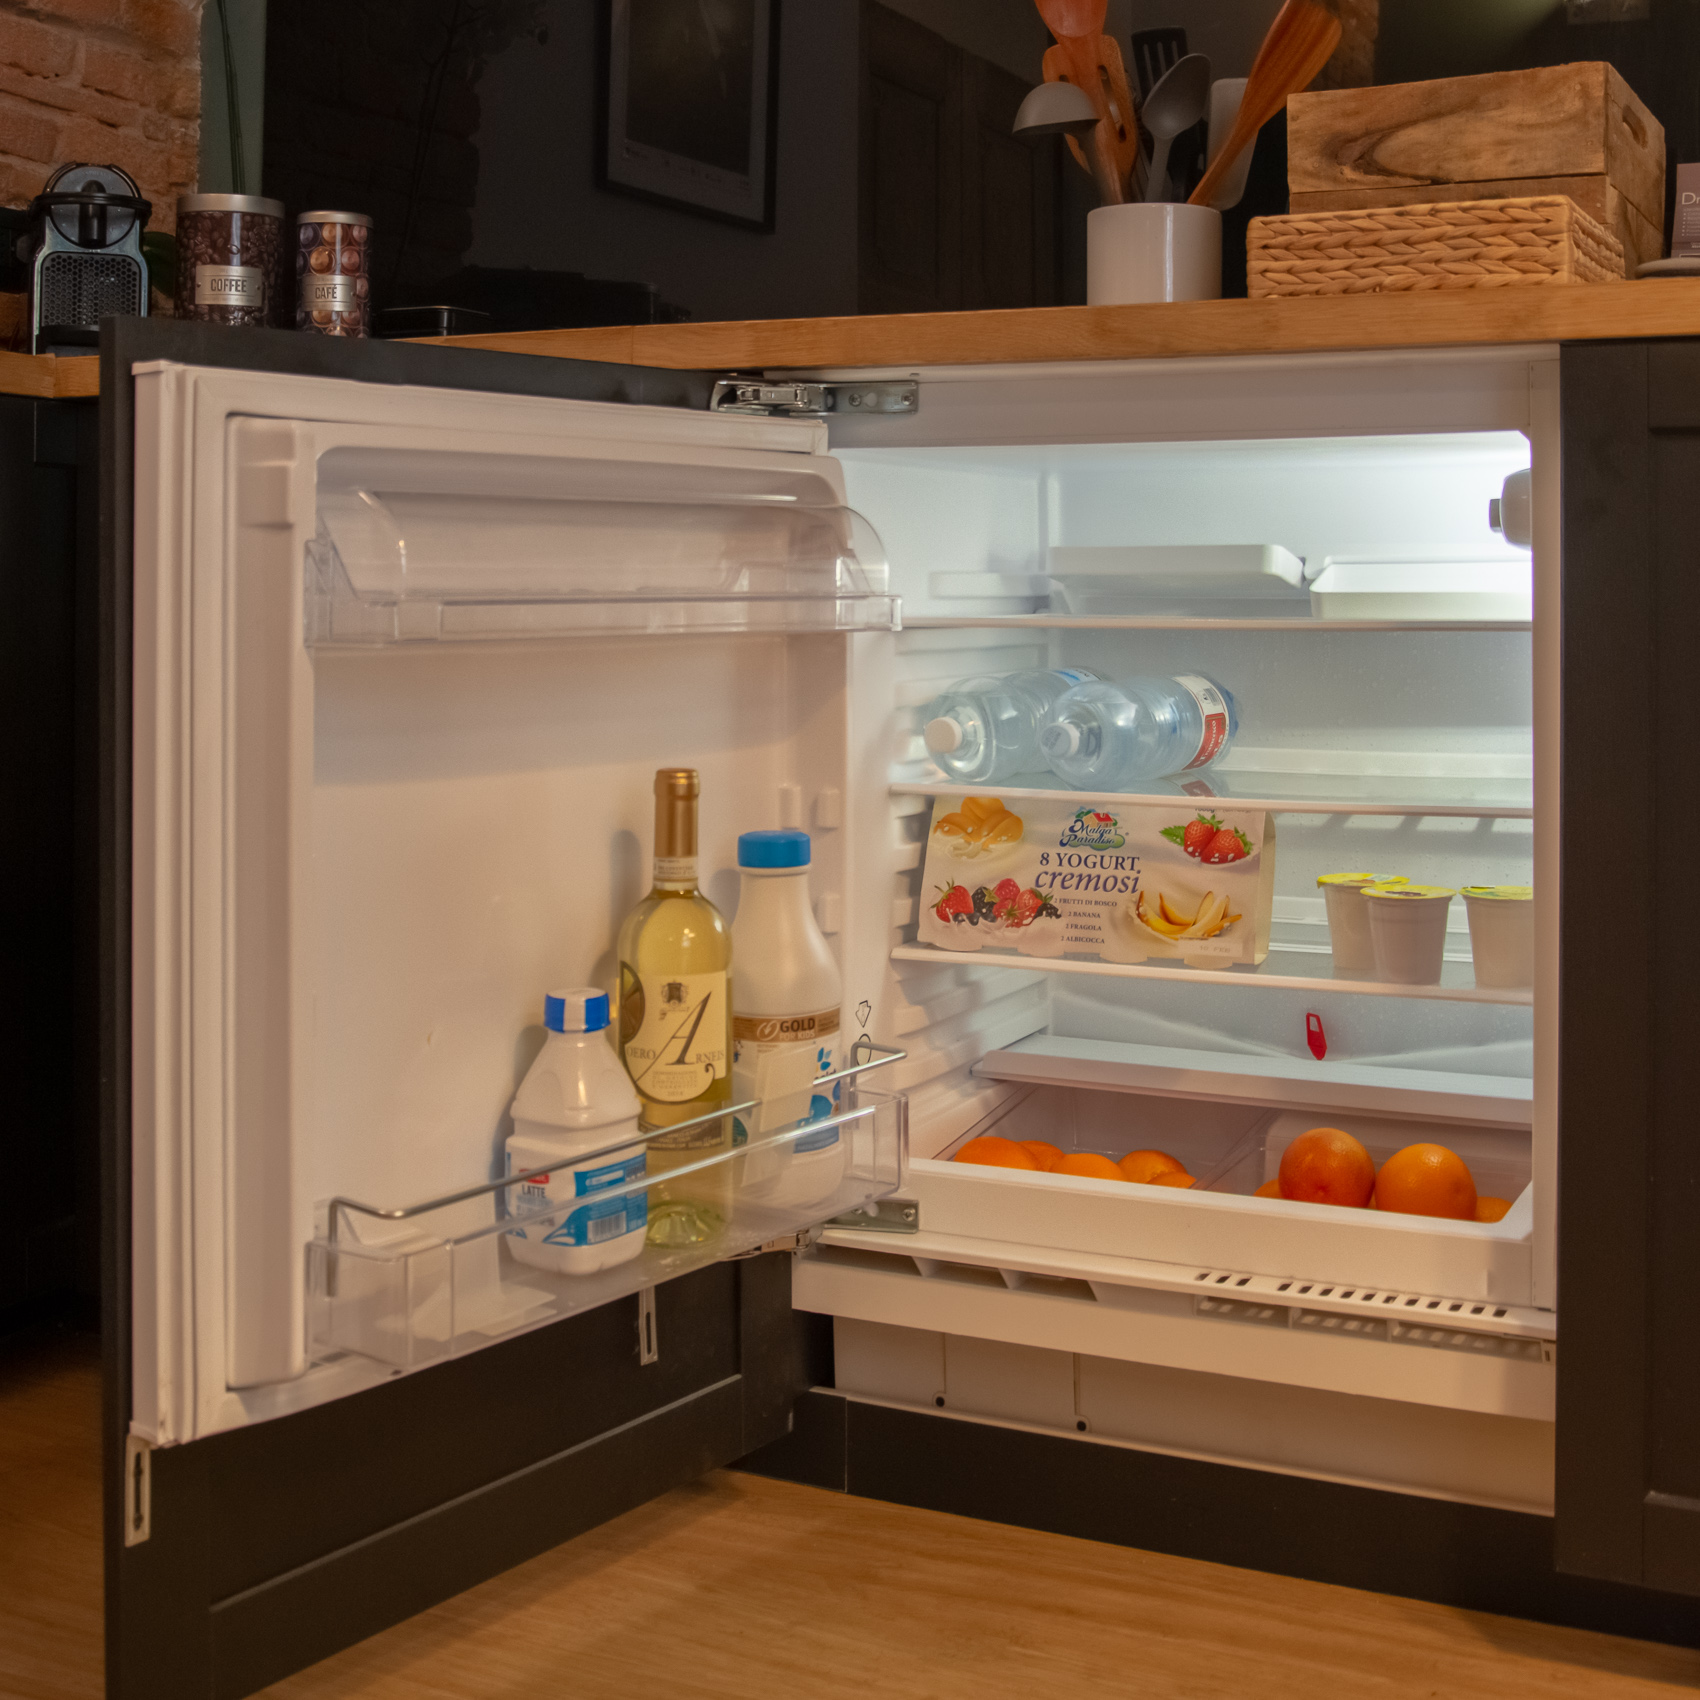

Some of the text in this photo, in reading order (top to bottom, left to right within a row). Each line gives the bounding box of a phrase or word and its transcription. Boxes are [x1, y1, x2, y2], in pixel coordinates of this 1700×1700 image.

[211, 279, 247, 293] COFFEE
[315, 285, 337, 299] CAFÉ
[1069, 819, 1112, 837] Malga
[1059, 833, 1115, 847] Paradiso
[1040, 852, 1140, 871] 8 YOGURT
[1035, 869, 1141, 894] cremosi
[1066, 936, 1105, 944] ALBICOCCA
[780, 1018, 815, 1032] GOLD
[780, 1031, 815, 1041] FOR KIDS
[522, 1184, 545, 1198] LATTE
